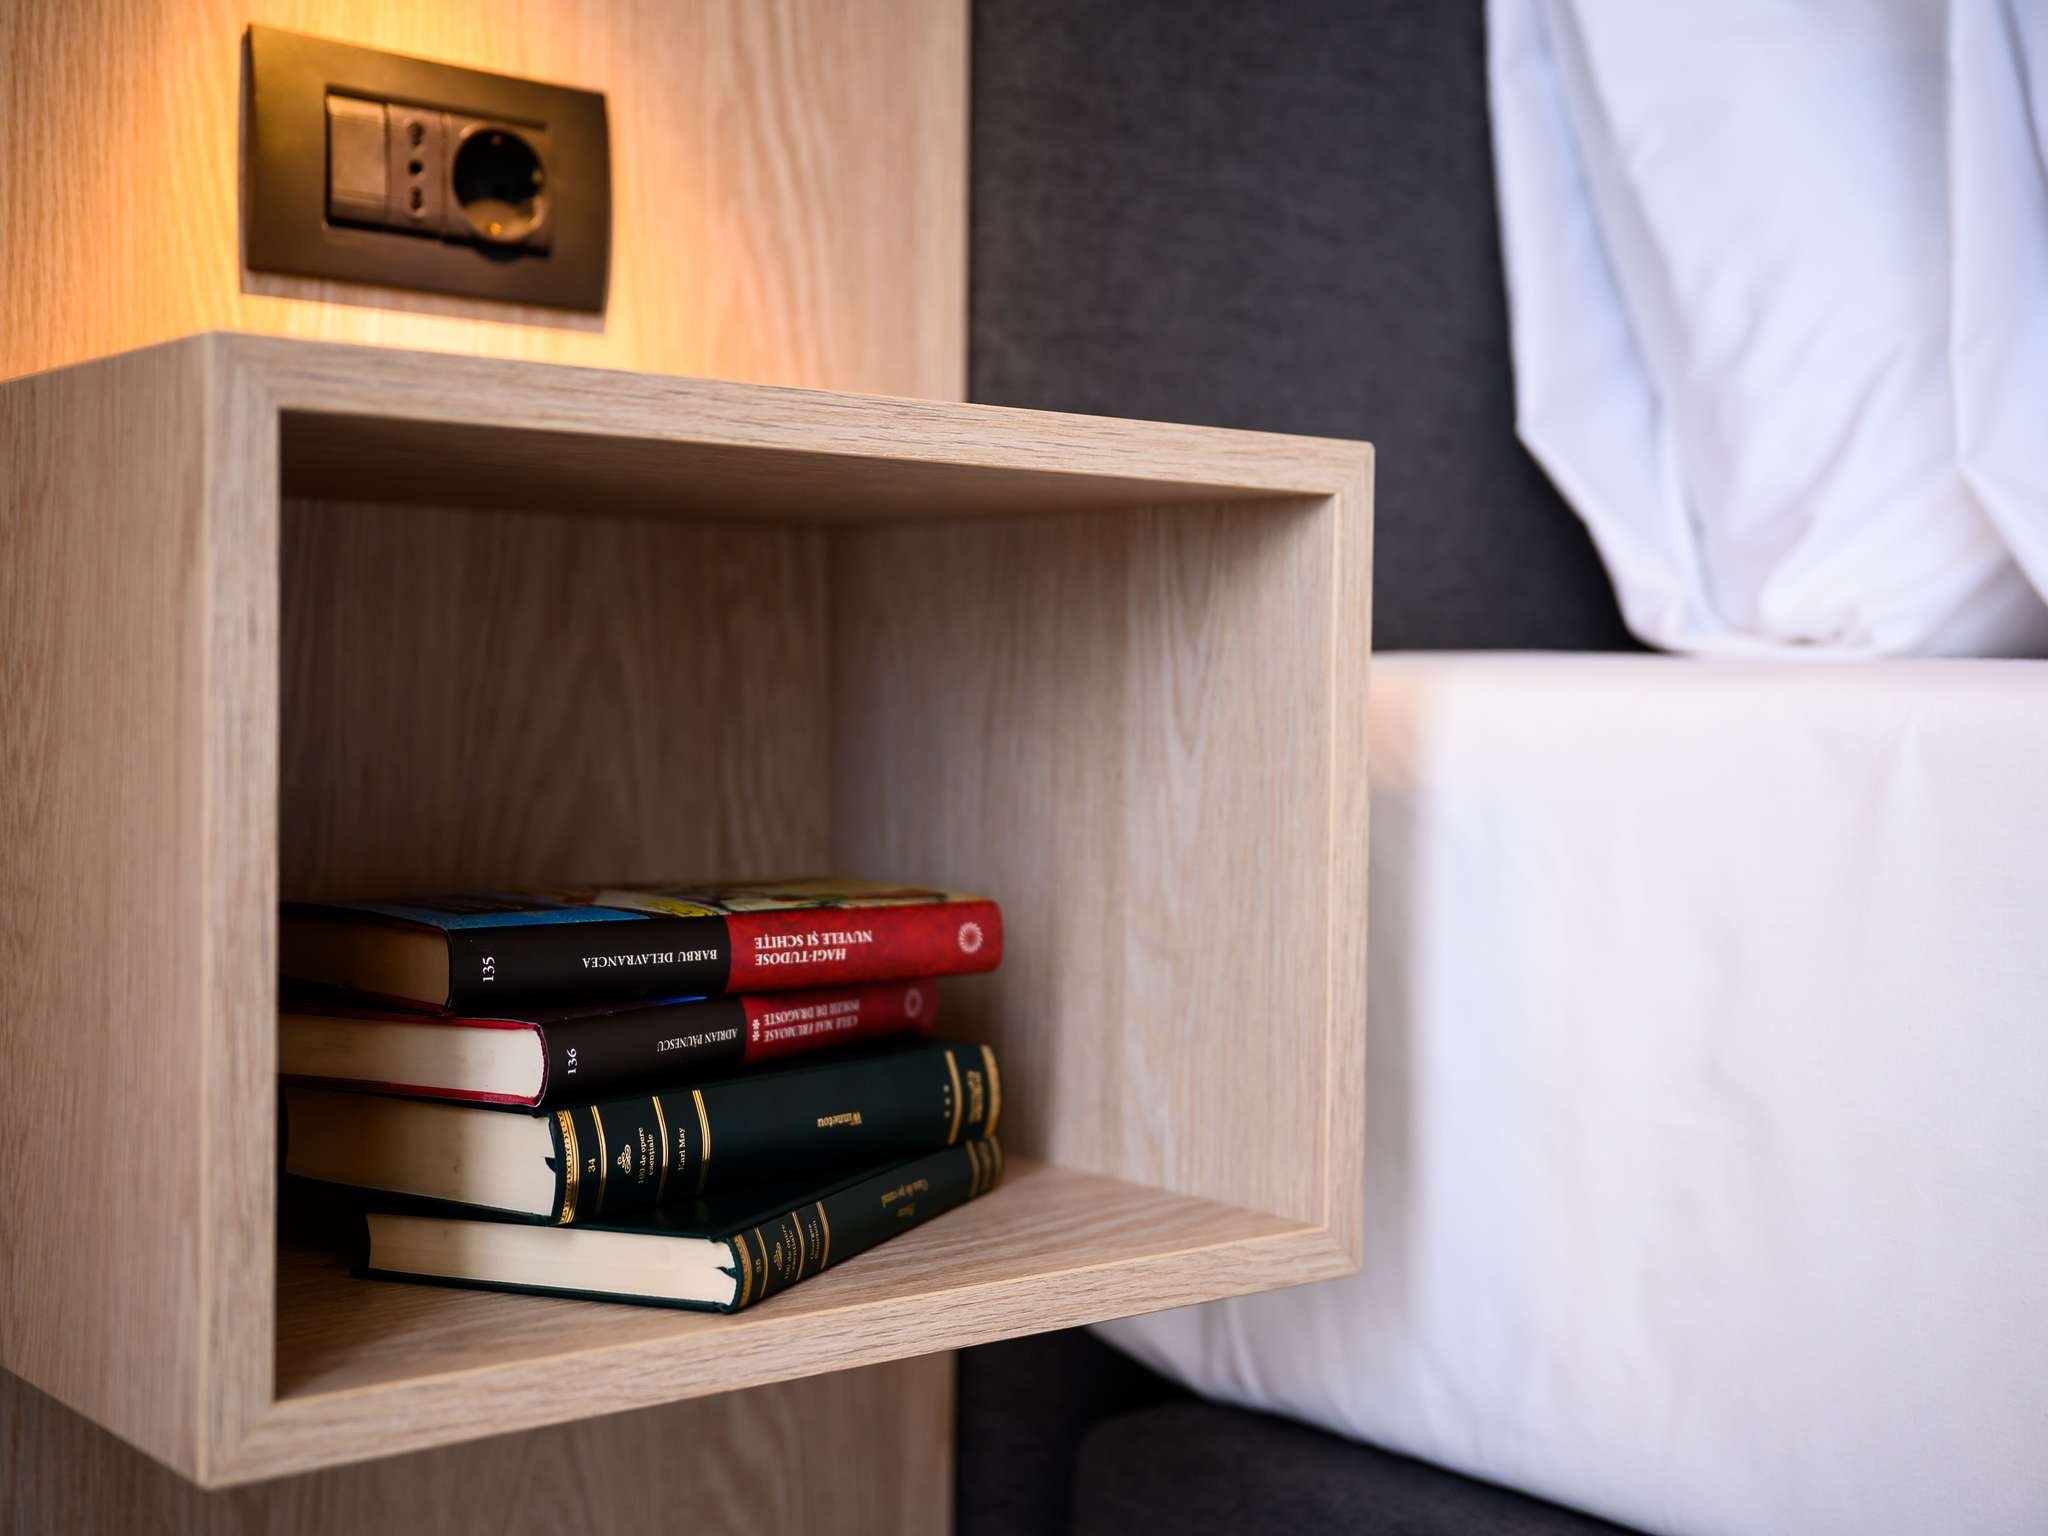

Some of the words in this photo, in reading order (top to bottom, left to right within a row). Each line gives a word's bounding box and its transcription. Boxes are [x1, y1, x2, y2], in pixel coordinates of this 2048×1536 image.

[821, 929, 872, 946] NUVELE
[582, 952, 674, 969] DELAVRANCEA
[677, 949, 717, 963] BARBU
[482, 956, 495, 983] 135
[763, 1007, 814, 1026] DRAGOSTE
[704, 1028, 738, 1044] ADRIAN
[566, 1048, 578, 1075] 136
[637, 1127, 647, 1153] opere
[678, 1127, 687, 1149] May
[587, 1158, 597, 1173] 34
[639, 1154, 647, 1167] de
[678, 1150, 686, 1171] Karl
[637, 1168, 646, 1184] 100
